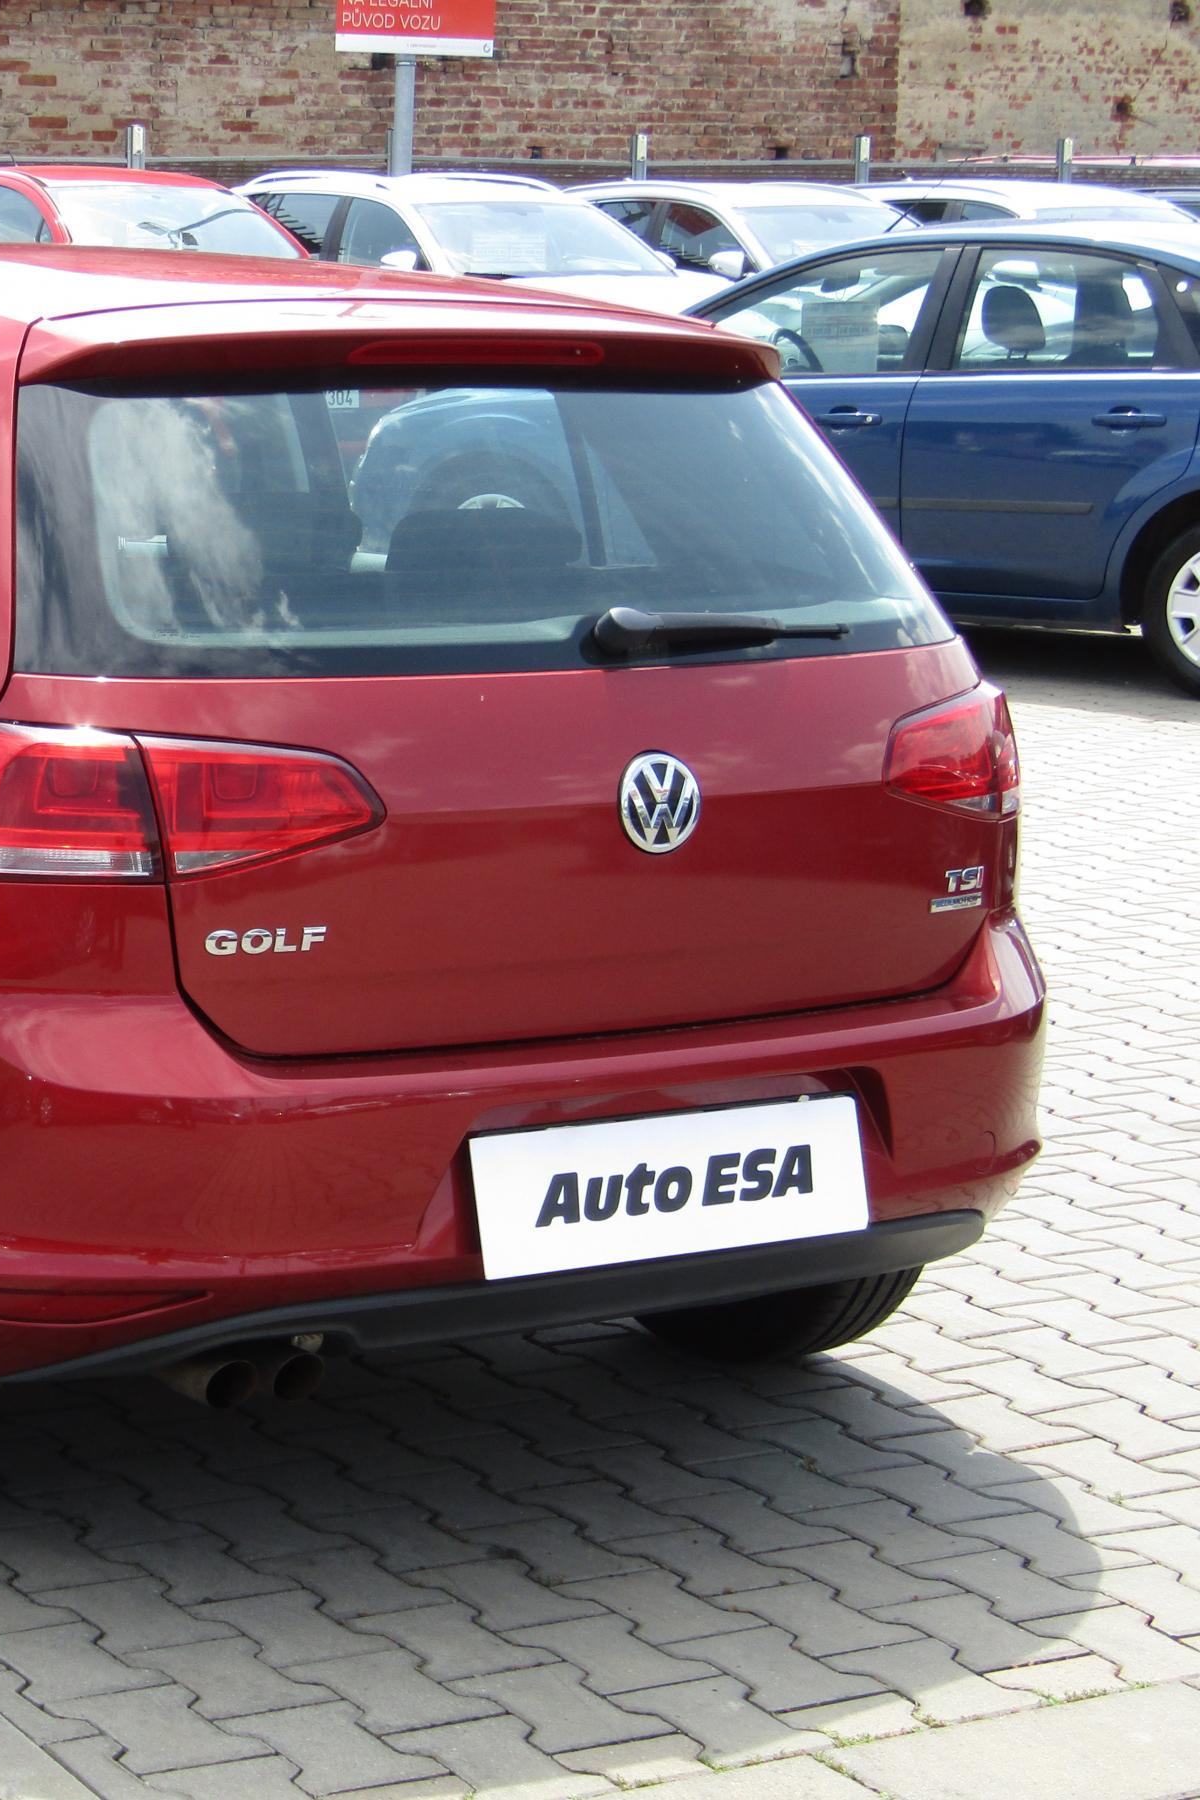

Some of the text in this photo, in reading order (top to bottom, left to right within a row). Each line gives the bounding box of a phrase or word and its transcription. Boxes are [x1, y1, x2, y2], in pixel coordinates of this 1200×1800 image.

[342, 8, 441, 31] PŮVOD VOZU
[945, 865, 984, 893] TSI
[205, 926, 327, 955] GOLF
[535, 1144, 814, 1228] Auto ESA
